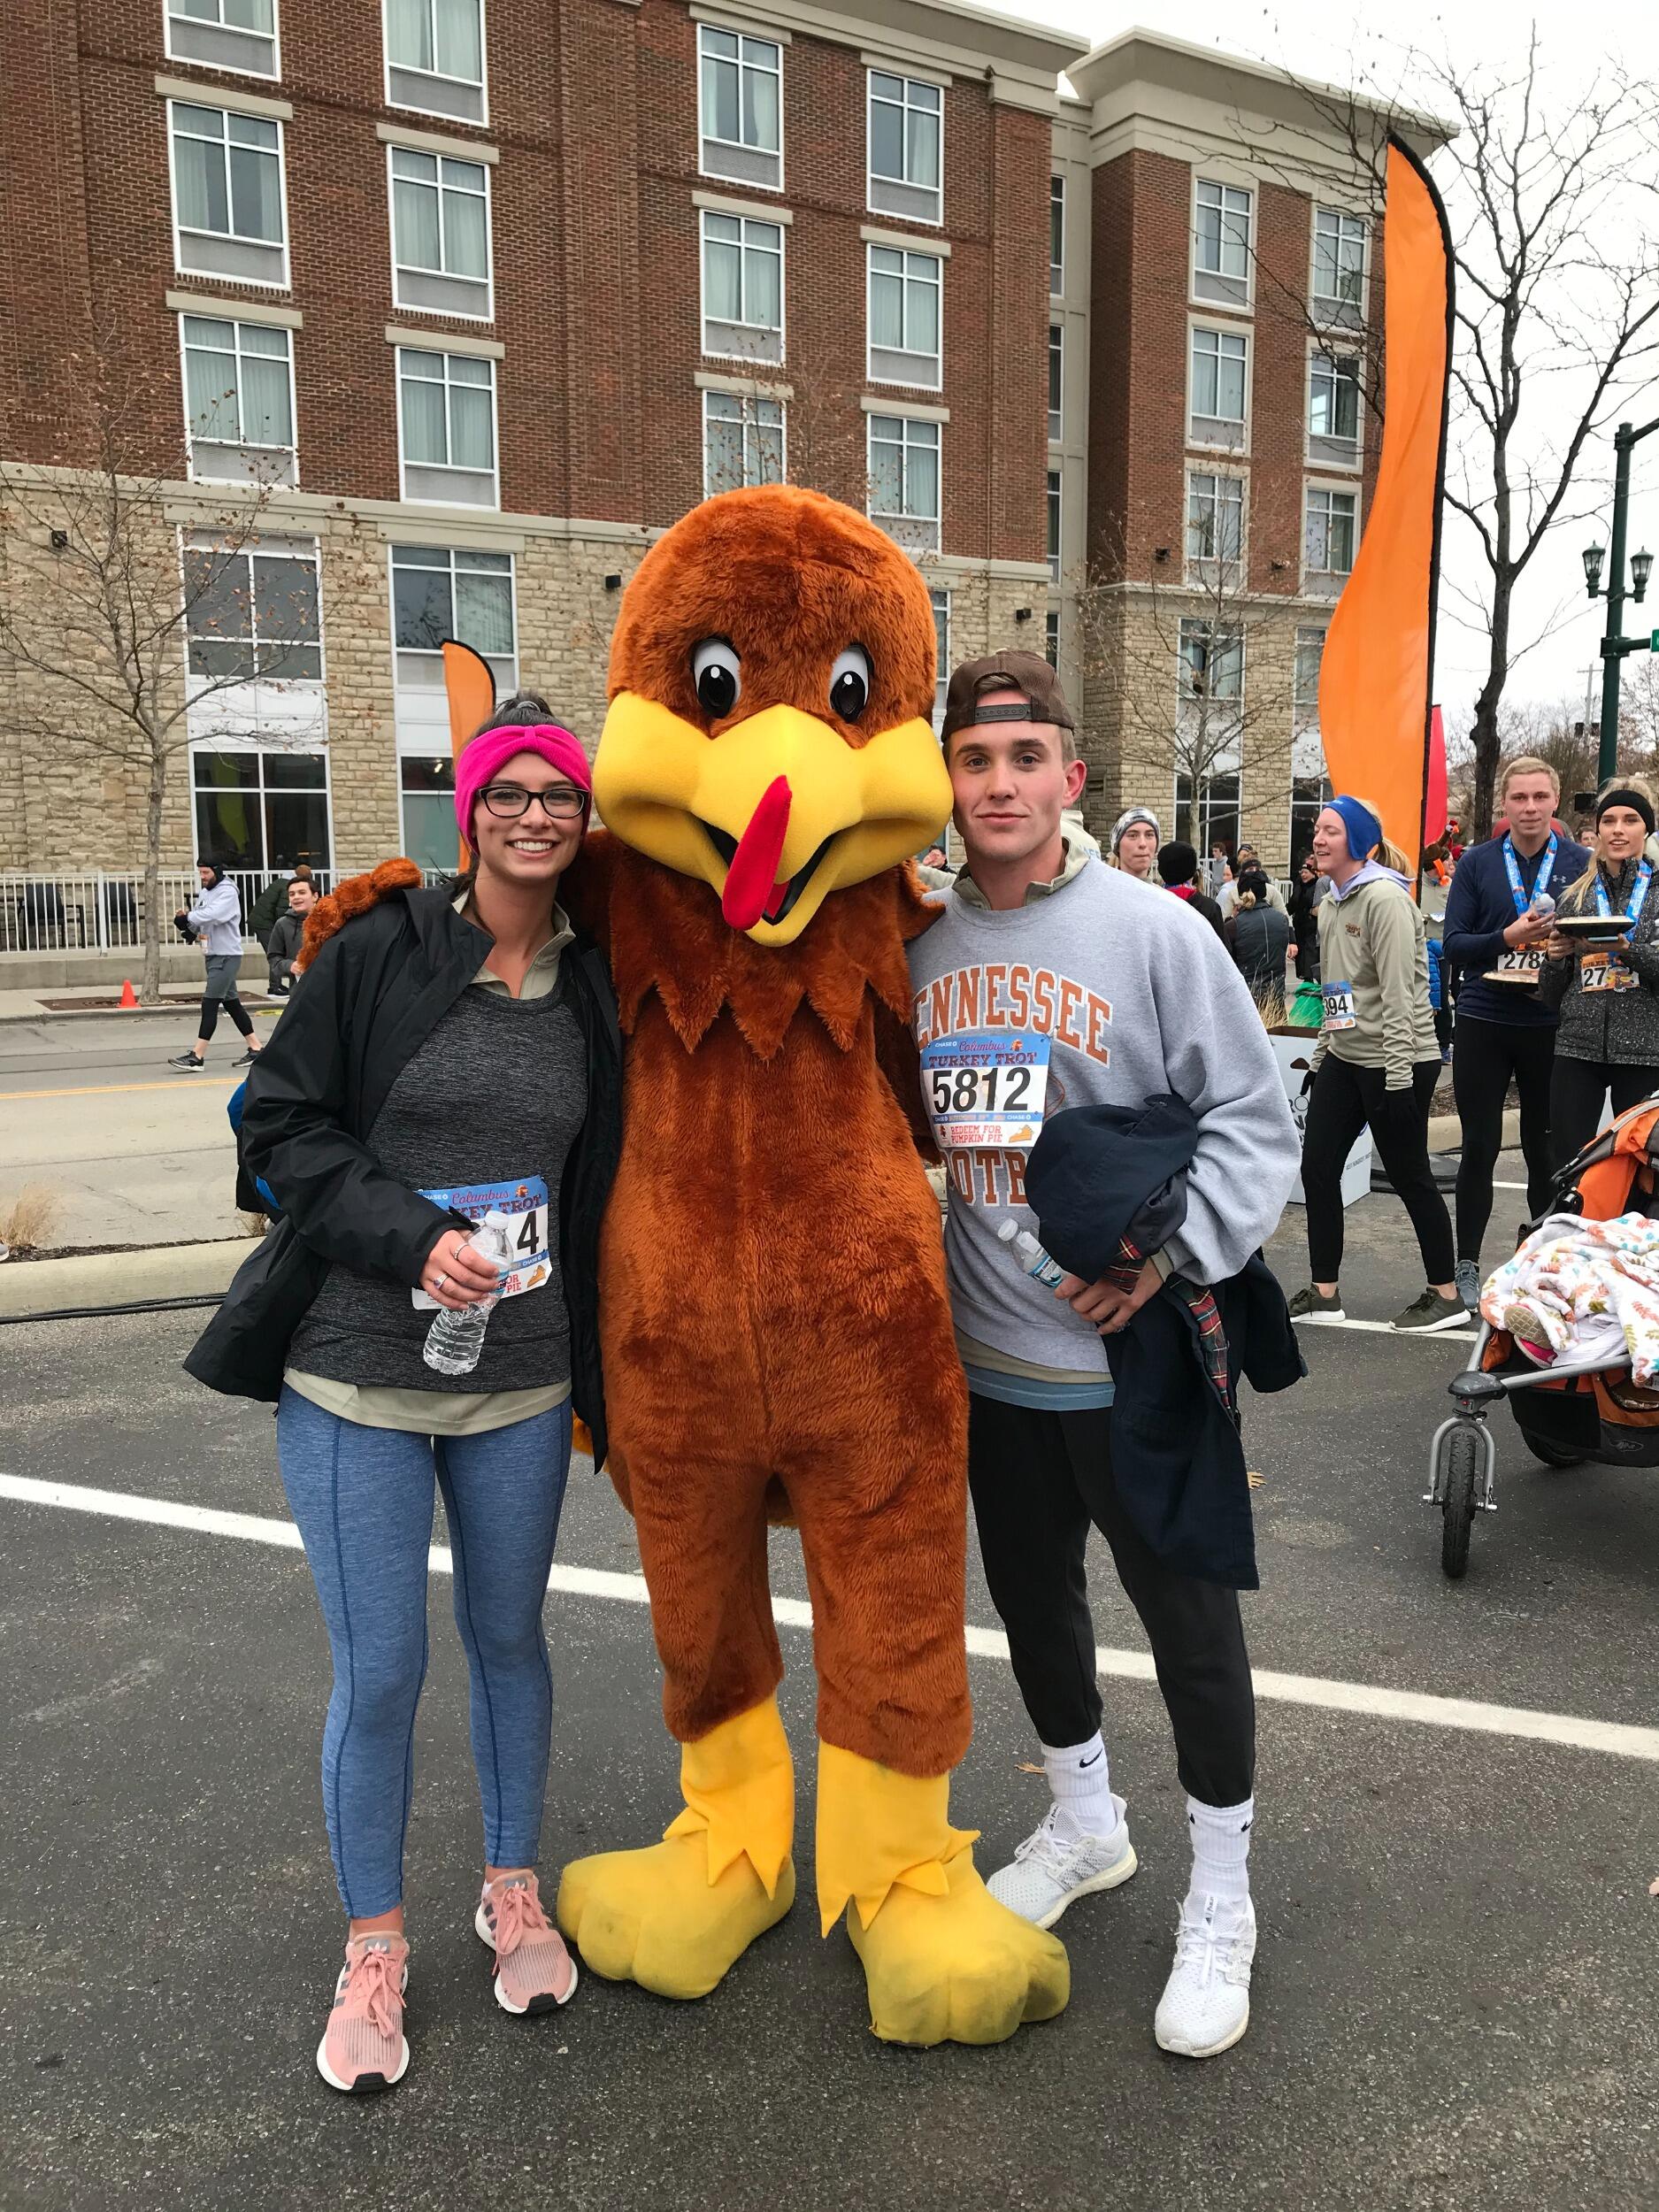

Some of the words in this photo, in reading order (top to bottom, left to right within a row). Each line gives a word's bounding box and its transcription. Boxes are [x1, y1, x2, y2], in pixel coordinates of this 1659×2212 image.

[1584, 966, 1611, 987] 27
[913, 963, 1113, 1069] ENNESSEE
[959, 1039, 1006, 1052] Columbus
[929, 1054, 990, 1068] TURKEY
[995, 1052, 1037, 1064] TROT
[933, 1067, 1031, 1114] 5812
[950, 1125, 979, 1135] REDEEM
[983, 1125, 1002, 1134] FOR
[951, 1134, 984, 1144] PUMPKIN
[987, 1133, 1002, 1143] PIE
[941, 1148, 1029, 1206] OTB
[452, 1189, 510, 1204] Columbus
[454, 1203, 494, 1218] KEY
[499, 1194, 542, 1215] TROT
[505, 1274, 519, 1285] OR
[506, 1282, 522, 1293] PIE
